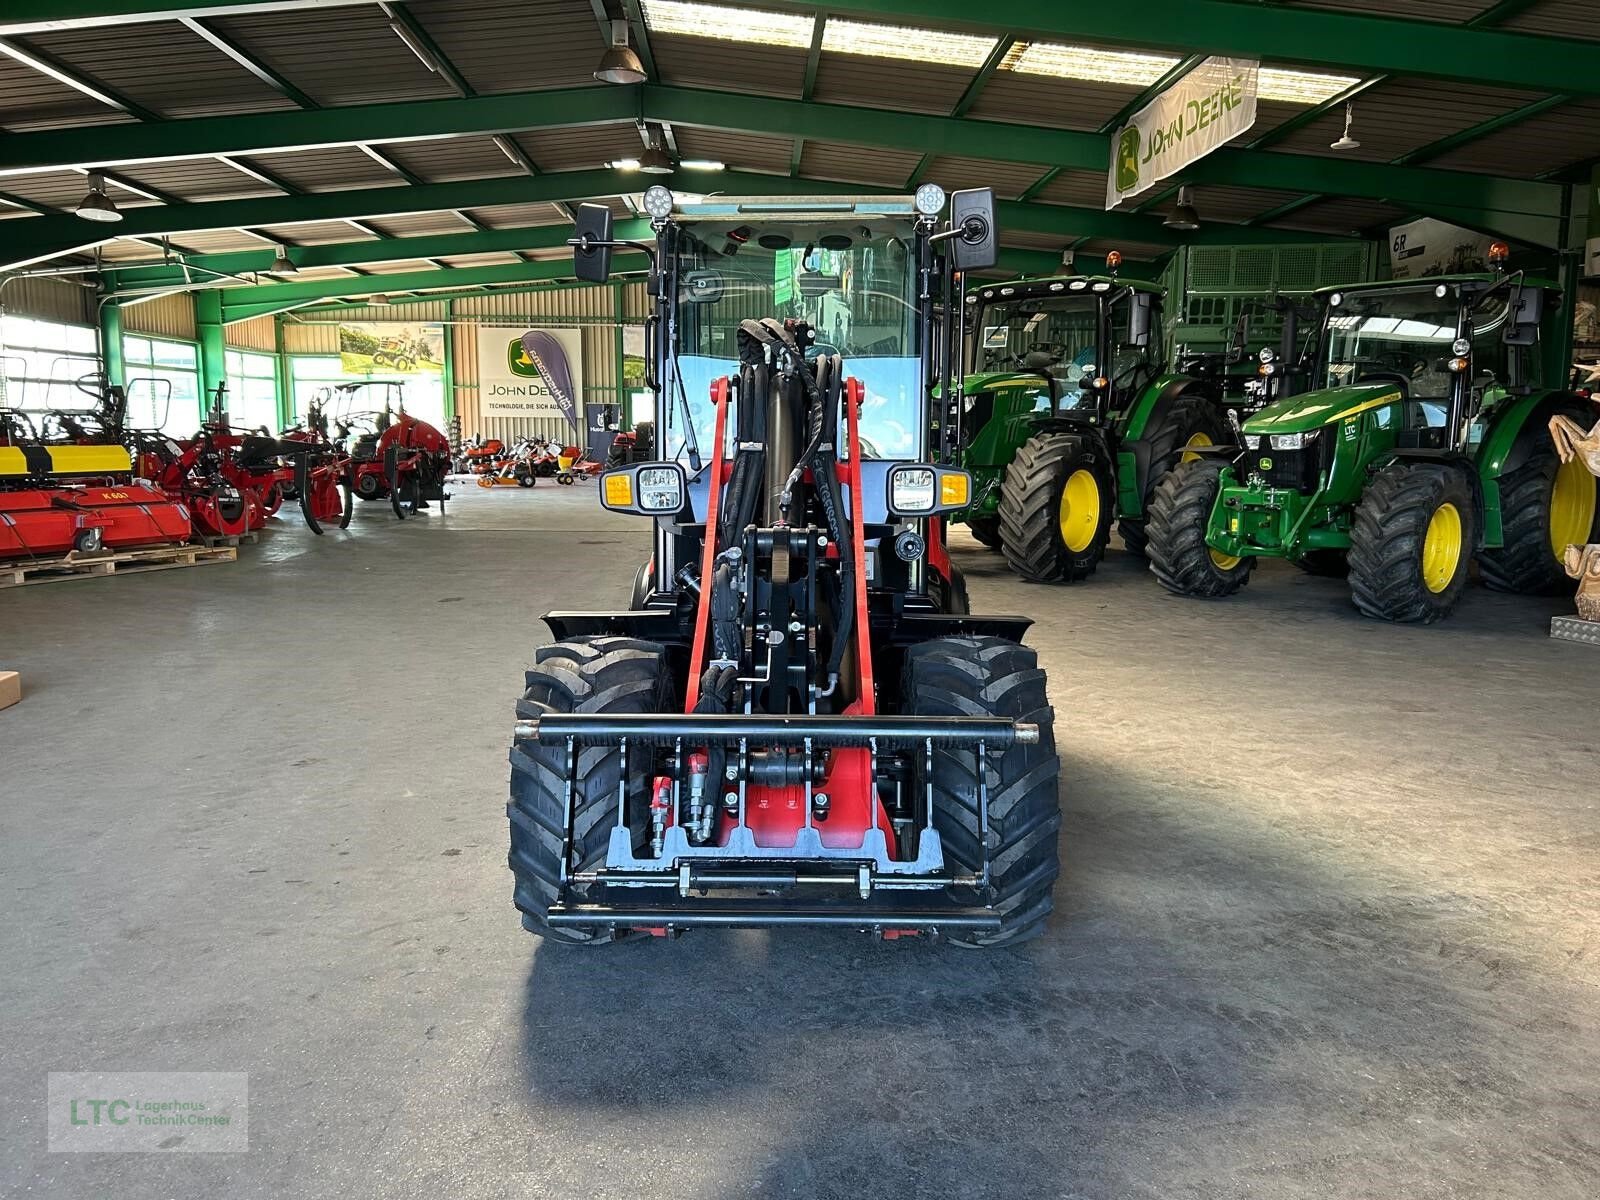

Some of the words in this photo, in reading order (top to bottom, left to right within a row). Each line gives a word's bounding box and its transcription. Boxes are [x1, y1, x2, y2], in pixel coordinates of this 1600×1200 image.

[1142, 114, 1184, 165] JOHN
[1186, 74, 1242, 136] DEERE
[488, 384, 526, 396] JOHN
